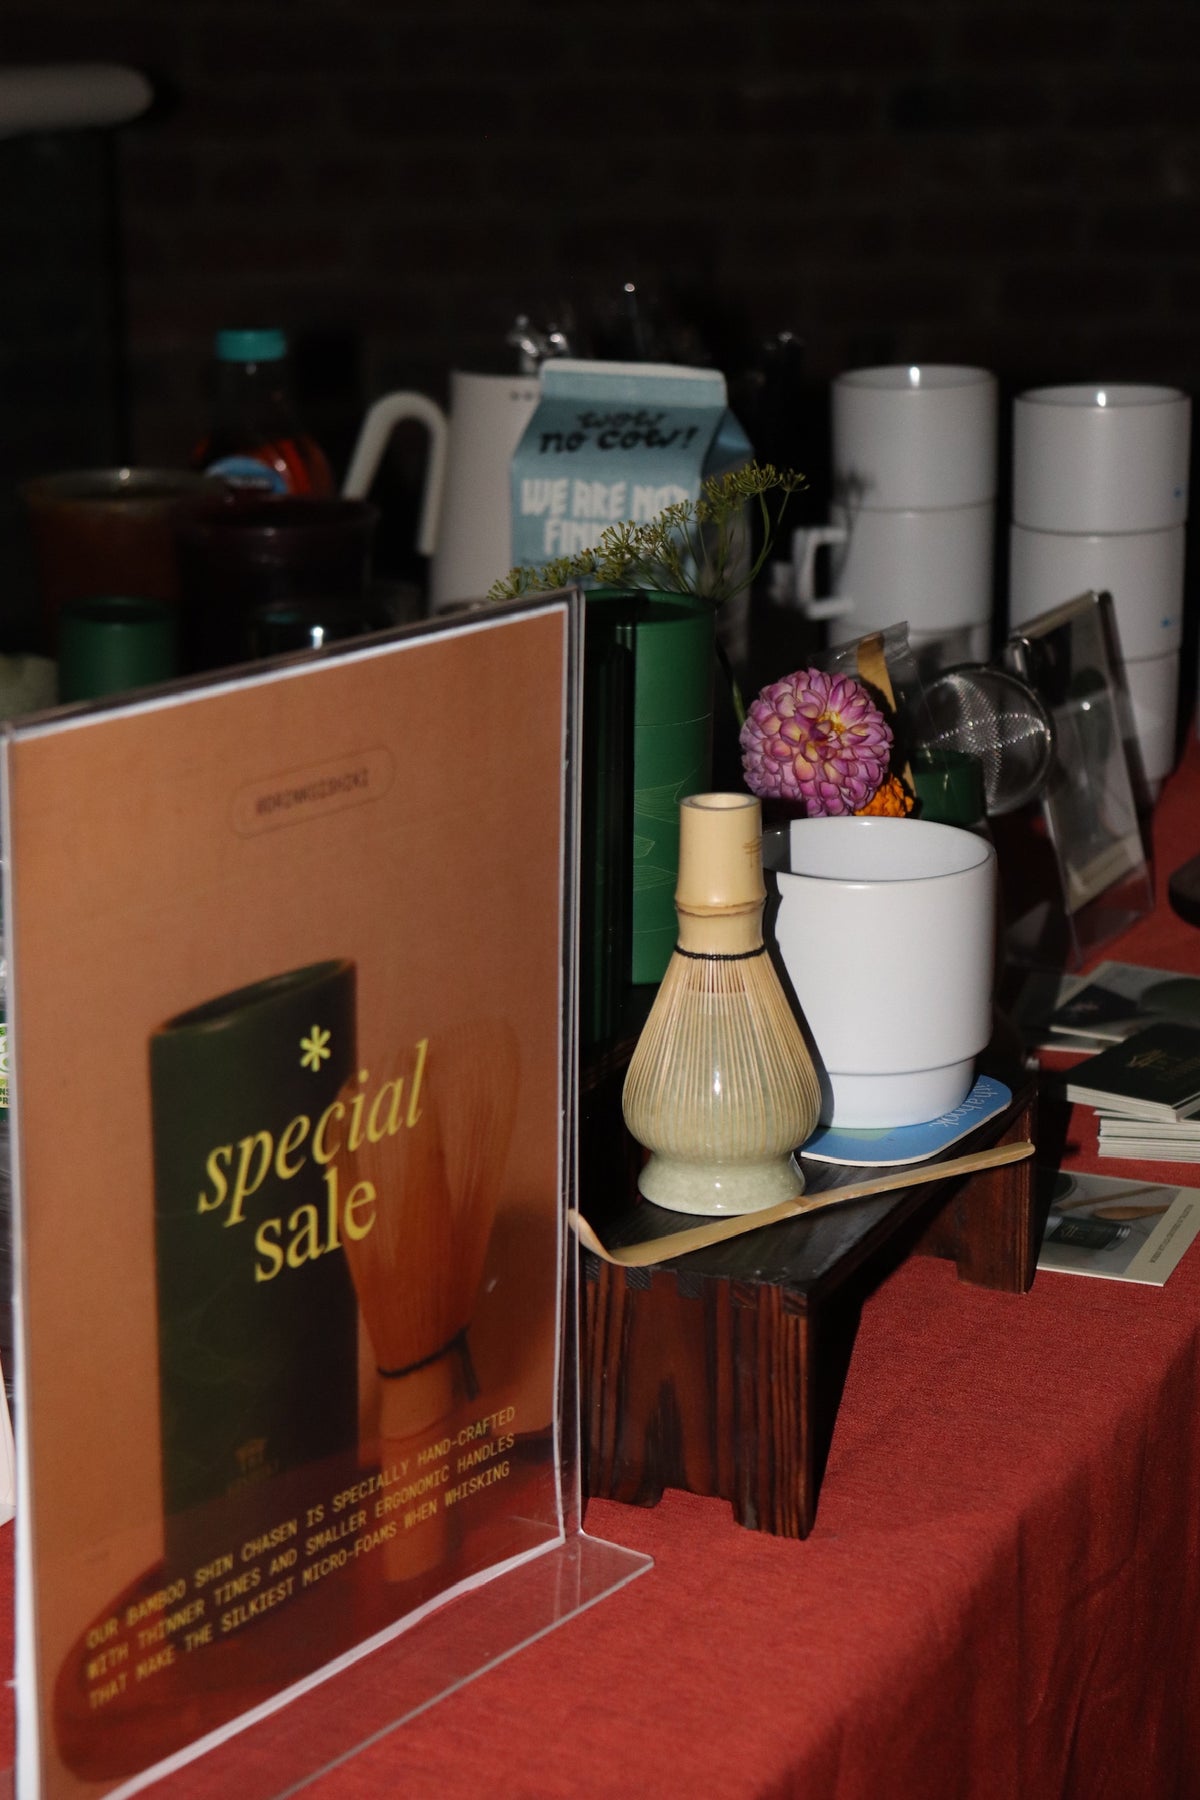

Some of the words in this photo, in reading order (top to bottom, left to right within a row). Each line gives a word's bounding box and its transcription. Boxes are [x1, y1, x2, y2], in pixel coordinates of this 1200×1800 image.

[521, 479, 569, 517] WE
[573, 480, 627, 520] ARE
[540, 430, 588, 455] no
[597, 426, 699, 451] cow!
[197, 1038, 429, 1228] special
[254, 1166, 377, 1282] sale
[87, 1617, 118, 1649] OUR
[127, 1578, 187, 1627] BAMBOO
[195, 1554, 234, 1588] SHIN
[241, 1519, 298, 1562] CHASEN
[306, 1503, 324, 1528] IS
[333, 1460, 409, 1512] SPECIALLY
[417, 1406, 516, 1467] HAND-CRAFTED
[87, 1642, 129, 1680] WITH
[138, 1598, 205, 1648] THINNER
[213, 1567, 261, 1606] TINES
[269, 1548, 297, 1576] AND
[306, 1510, 367, 1556] SMALLER
[375, 1464, 450, 1519] ERGONOMIC
[457, 1432, 515, 1474] HANDLES
[90, 1673, 127, 1709] THAT
[135, 1644, 175, 1681] MAKE
[184, 1622, 213, 1652] THE
[220, 1577, 294, 1633] SILKIEST
[302, 1521, 397, 1587] MICRO-FOAMS
[404, 1499, 438, 1530] WHEN
[444, 1460, 511, 1507] WHISKING
